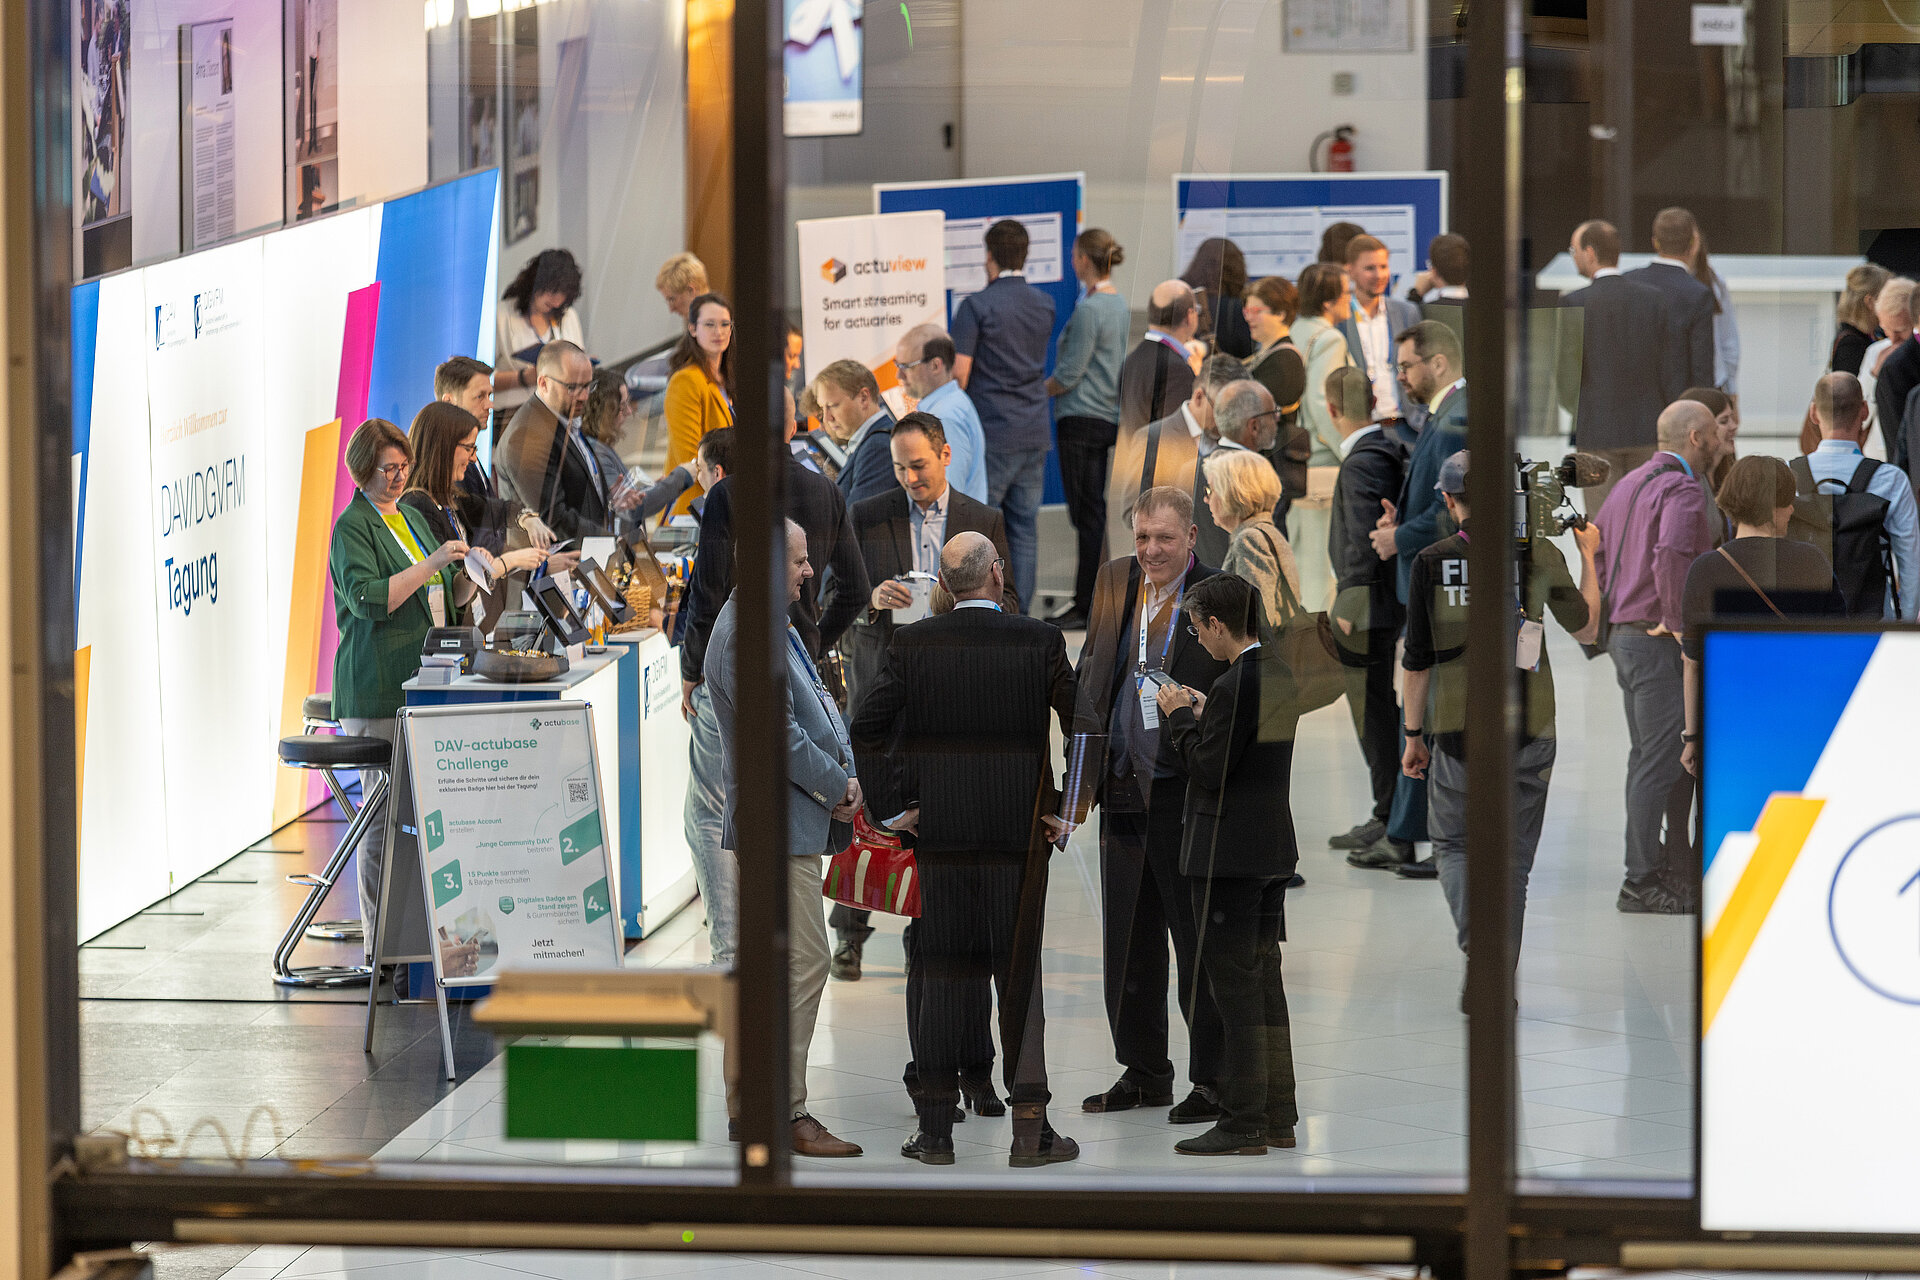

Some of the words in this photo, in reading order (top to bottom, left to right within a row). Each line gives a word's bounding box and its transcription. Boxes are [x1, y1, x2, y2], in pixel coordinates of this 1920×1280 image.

[853, 254, 927, 275] actuview
[822, 296, 861, 311] Smart
[863, 290, 927, 308] streaming
[823, 317, 840, 331] for
[844, 313, 902, 329] actuaries
[183, 411, 218, 437] Willkommen
[161, 454, 246, 537] DAV/DGVFM
[164, 552, 219, 617] Tagung
[544, 718, 580, 727] actubase
[434, 737, 538, 753] DAV-actubase
[436, 757, 509, 772] Challenge
[438, 777, 456, 785] Erfülle
[465, 776, 487, 784] Schritte
[467, 785, 485, 793] Badge
[516, 782, 539, 791] Tagung!
[477, 817, 502, 825] Account
[427, 820, 441, 837] 1.
[449, 826, 475, 834] erstellen
[498, 839, 536, 848] Community
[562, 837, 580, 853] 2.
[526, 846, 555, 854] beitreten
[476, 870, 499, 878] Punkte
[499, 868, 530, 876] sammeln
[443, 873, 460, 889] 3.
[474, 878, 494, 887] Badge
[494, 876, 531, 885] freischalten
[516, 896, 545, 904] Digitales
[545, 895, 566, 903] Badge
[586, 895, 605, 912] 4.
[537, 903, 556, 911] Stand
[556, 902, 578, 911] zeigen
[531, 910, 579, 919] Gummibärchen
[557, 917, 580, 925] sichern
[531, 938, 554, 948] Jetzt
[533, 948, 585, 960] mitmachen!
